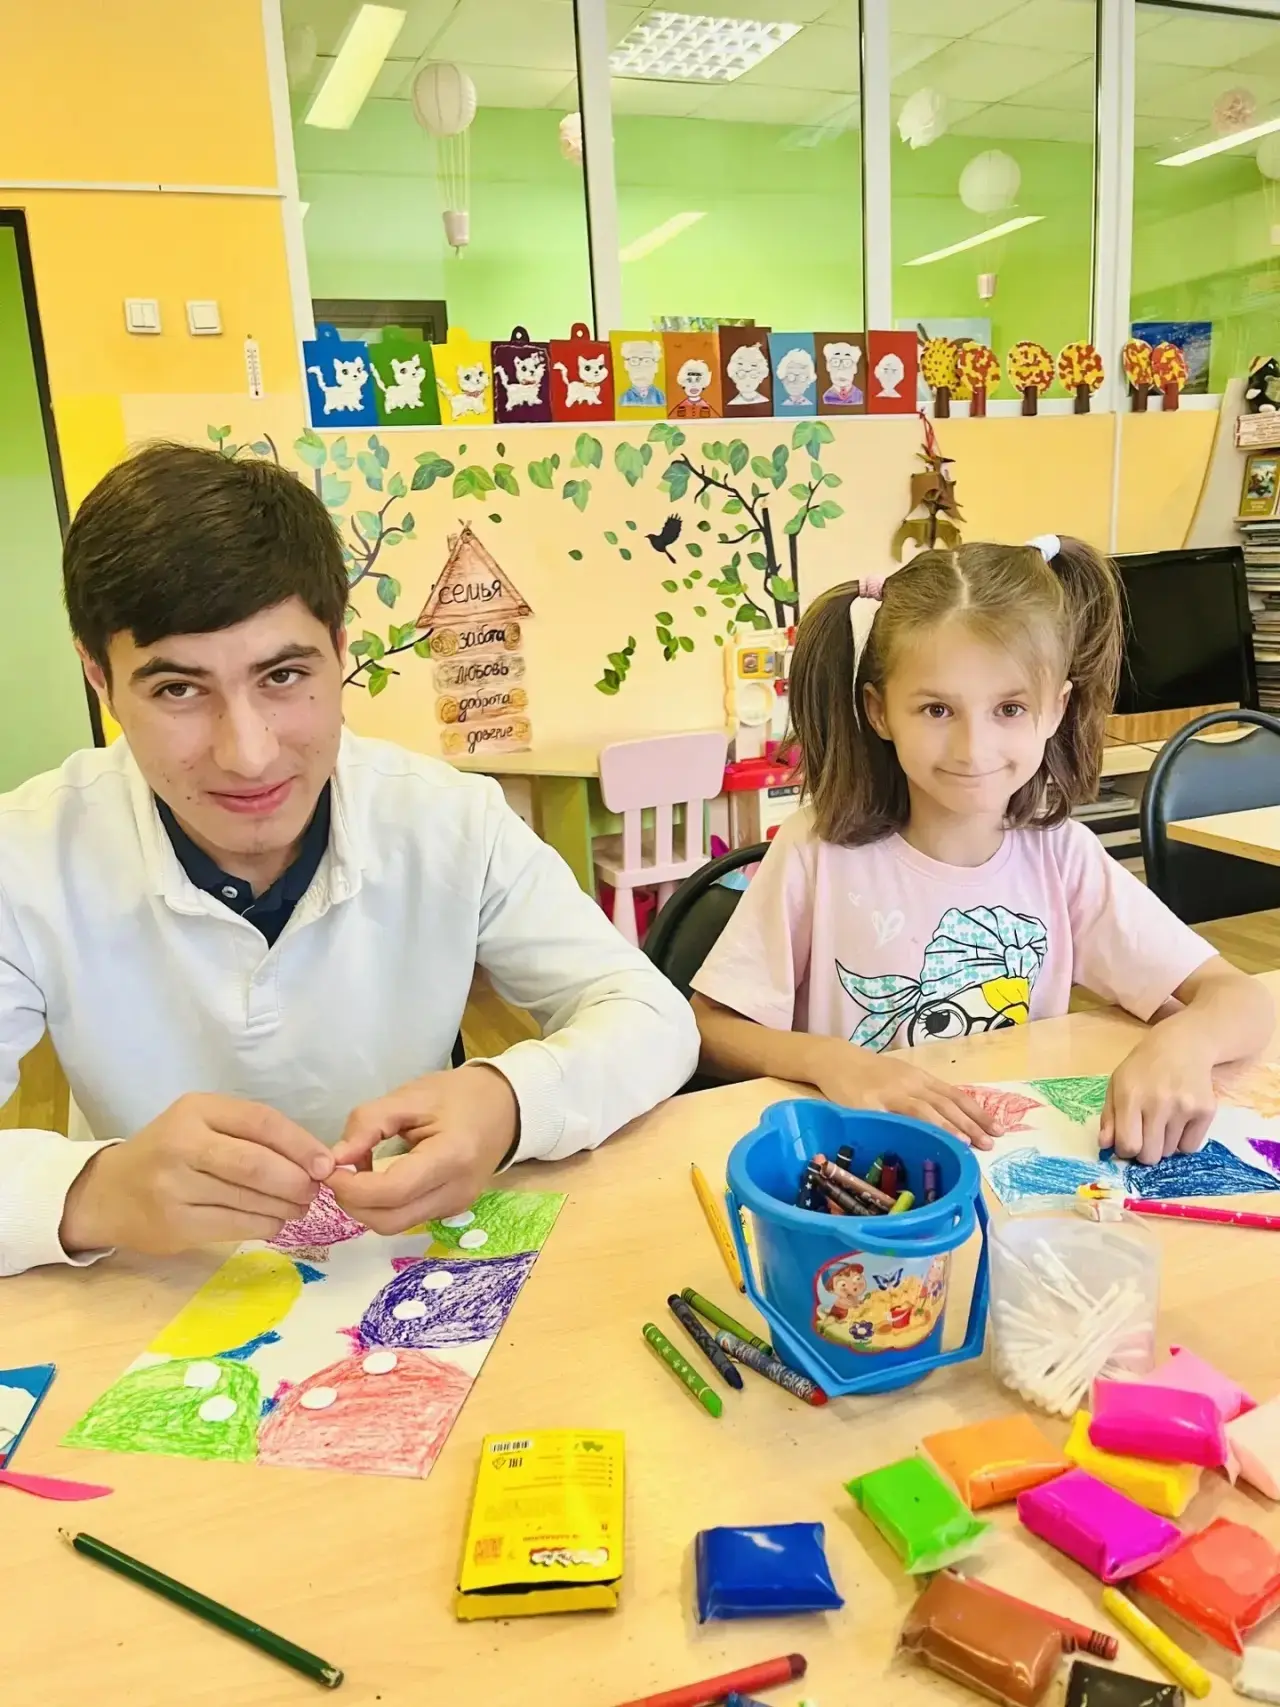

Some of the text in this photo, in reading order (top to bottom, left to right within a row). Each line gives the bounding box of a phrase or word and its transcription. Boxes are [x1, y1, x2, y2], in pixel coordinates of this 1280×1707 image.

[438, 579, 502, 605] семья
[458, 624, 506, 650] забота
[457, 688, 513, 722] доброта
